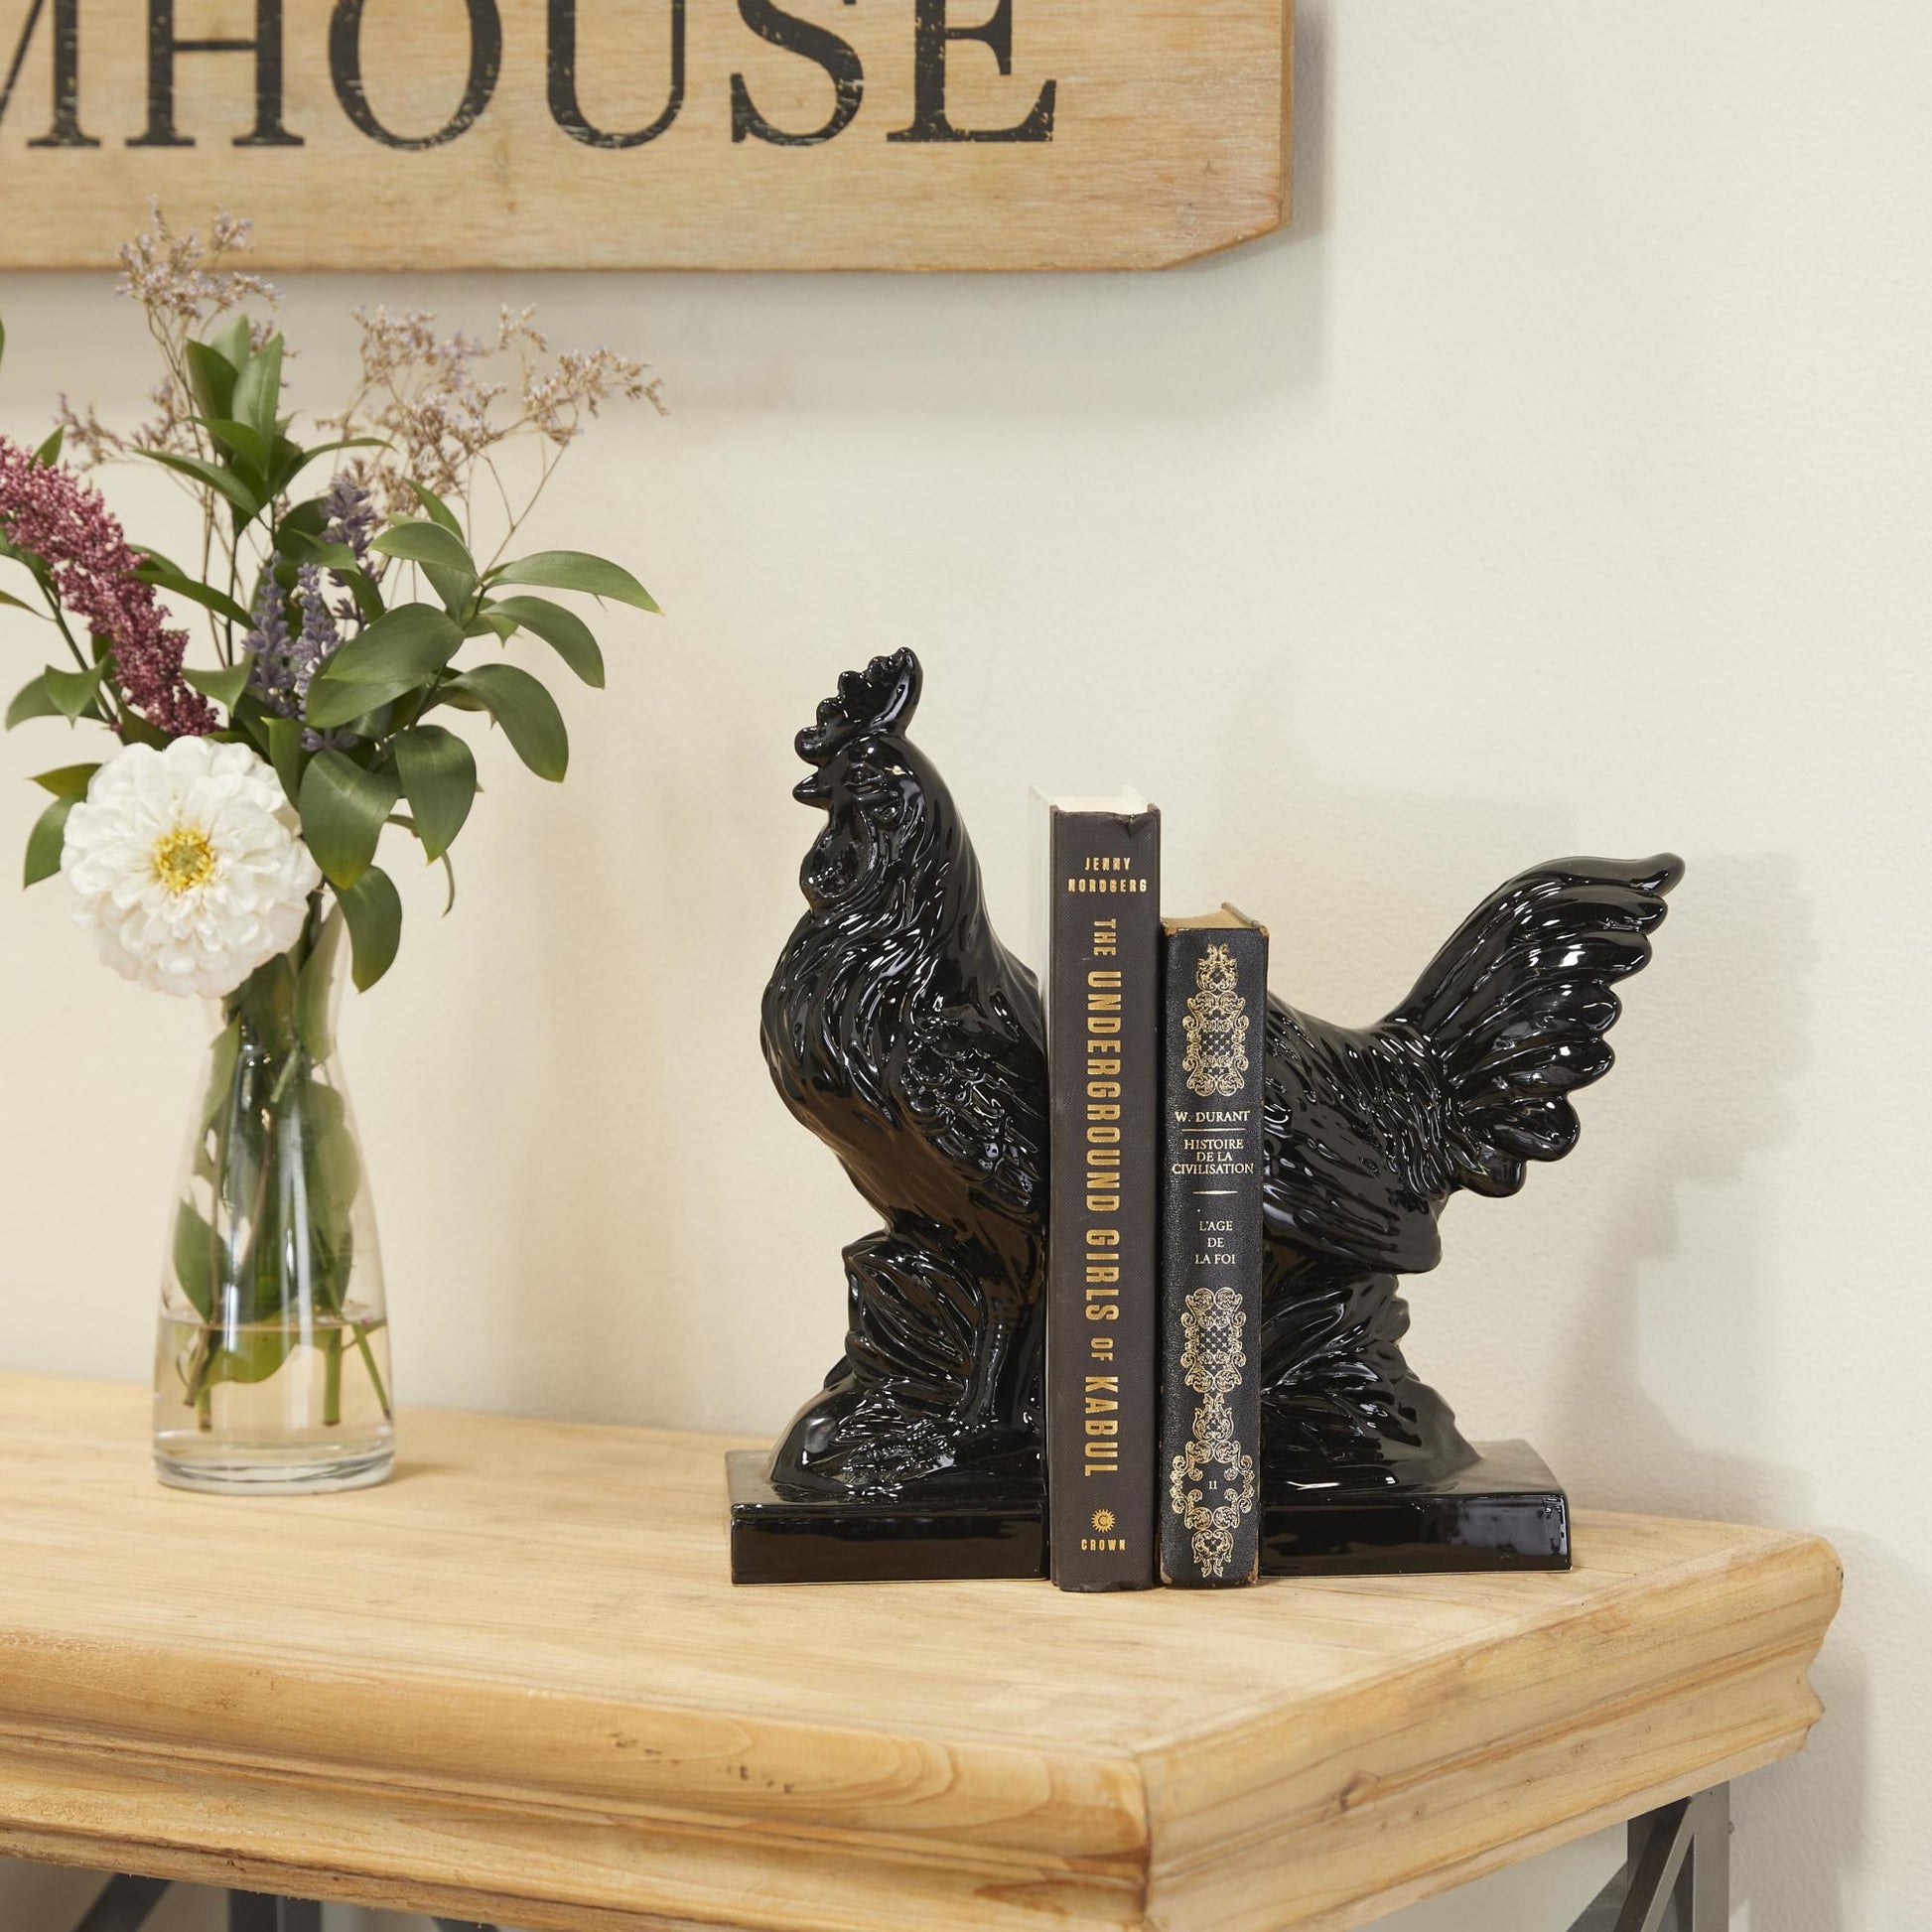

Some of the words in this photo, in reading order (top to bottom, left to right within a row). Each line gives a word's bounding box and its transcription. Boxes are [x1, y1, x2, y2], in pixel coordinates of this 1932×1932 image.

[1084, 857, 1131, 871] JENNY
[1067, 879, 1148, 893] NORDBERG
[1093, 917, 1117, 956] THE
[1086, 971, 1122, 1212] UNDERGROUND
[1174, 1111, 1191, 1122] W.
[1195, 1111, 1250, 1122] DURANT
[1183, 1139, 1244, 1150] HISTOIRE
[1196, 1152, 1214, 1162] DE
[1217, 1151, 1233, 1162] LA
[1172, 1163, 1254, 1174] CIVILISATION
[1198, 1220, 1233, 1232] L'AGE
[1207, 1237, 1224, 1248] DE
[1194, 1254, 1211, 1265] LA
[1214, 1253, 1236, 1265] FOI
[1085, 1229, 1121, 1321] GIRLS
[1090, 1337, 1114, 1361] OF
[1084, 1376, 1119, 1477] KABUL
[1080, 1538, 1126, 1552] CROWN
